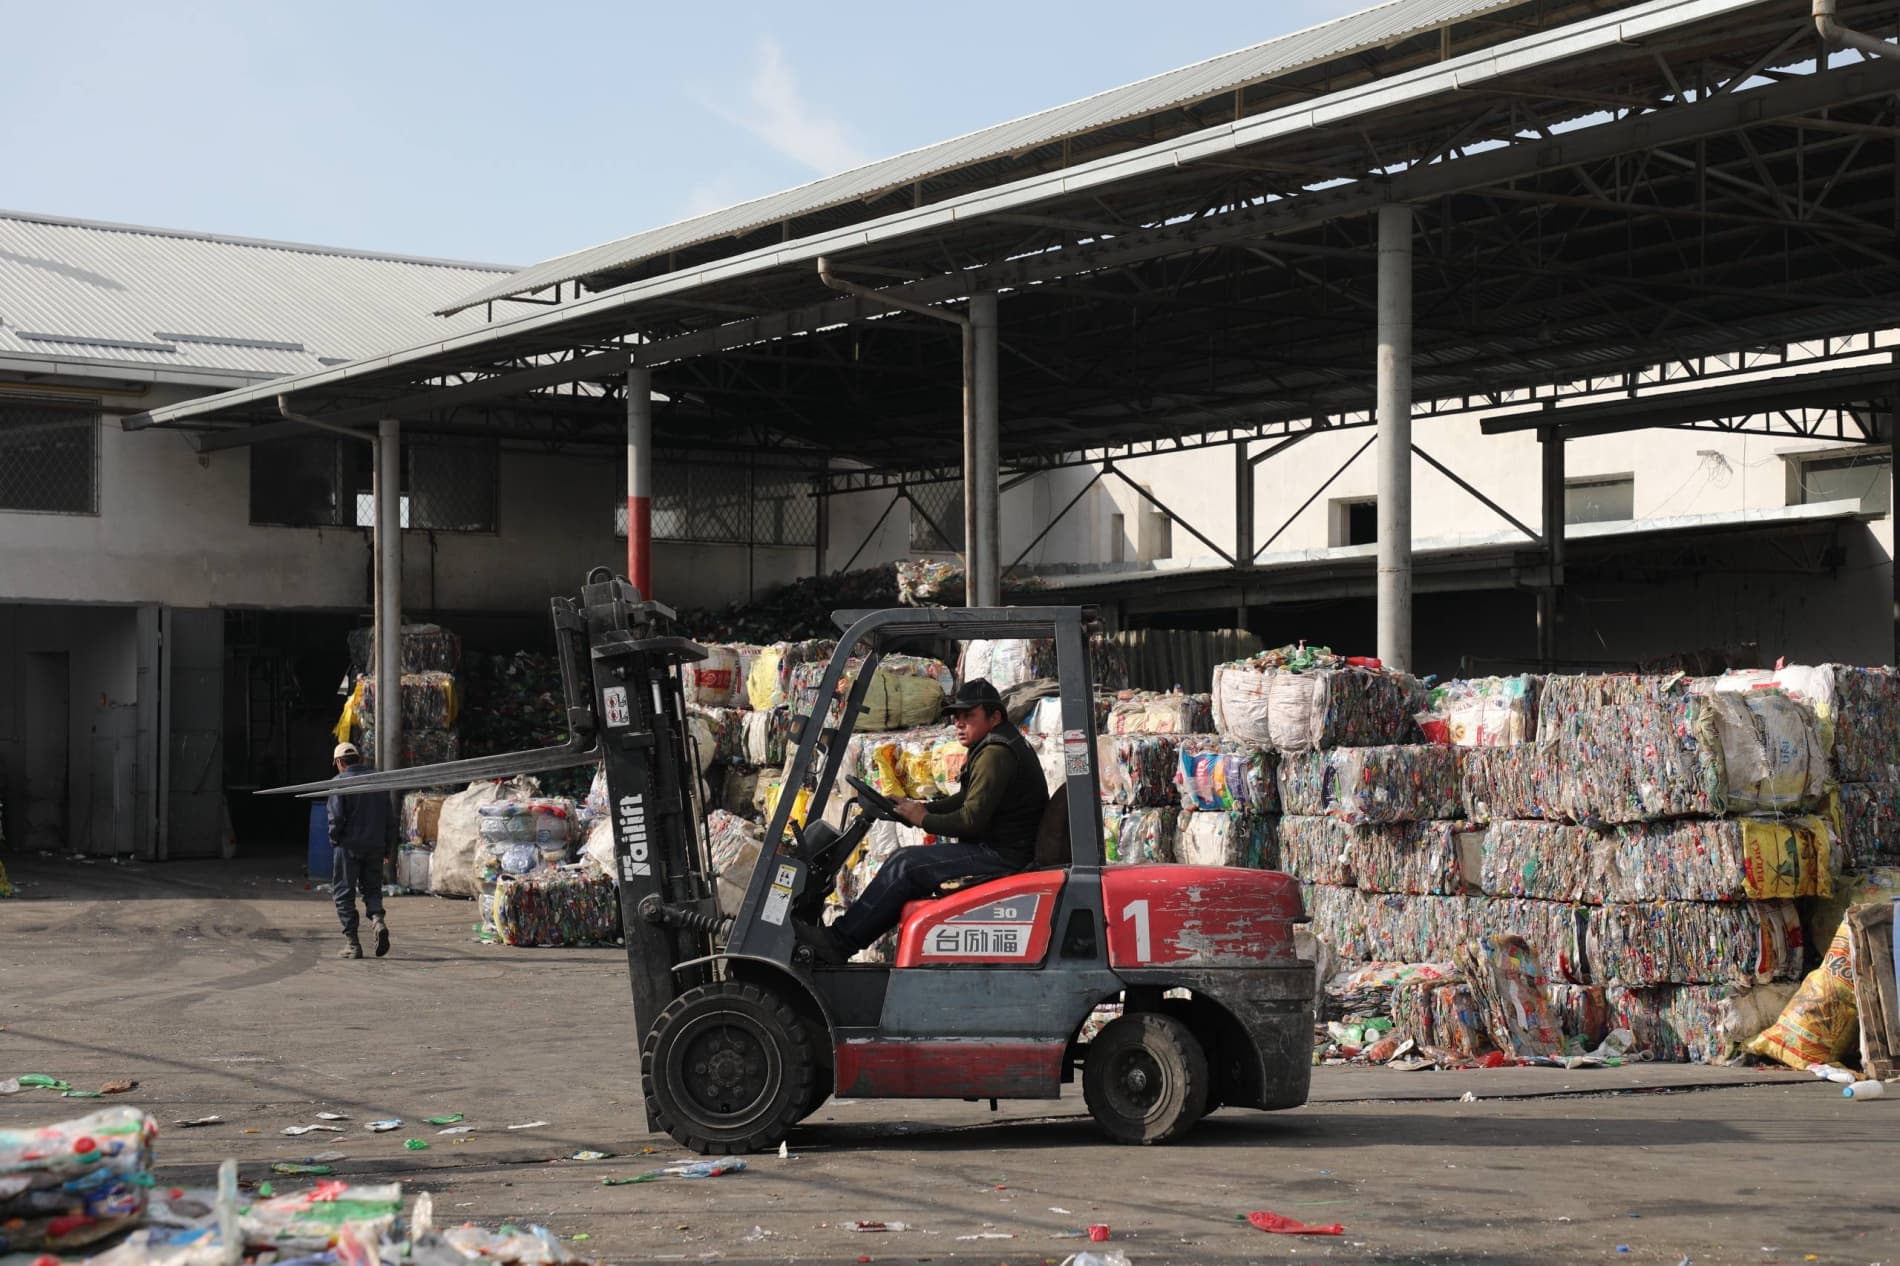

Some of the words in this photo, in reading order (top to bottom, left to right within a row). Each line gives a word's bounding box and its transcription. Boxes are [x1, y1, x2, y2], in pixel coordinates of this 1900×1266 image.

[619, 793, 651, 881] Tailift
[993, 907, 1017, 919] 30
[1122, 899, 1152, 963] 1
[936, 929, 1018, 953] 台励福
